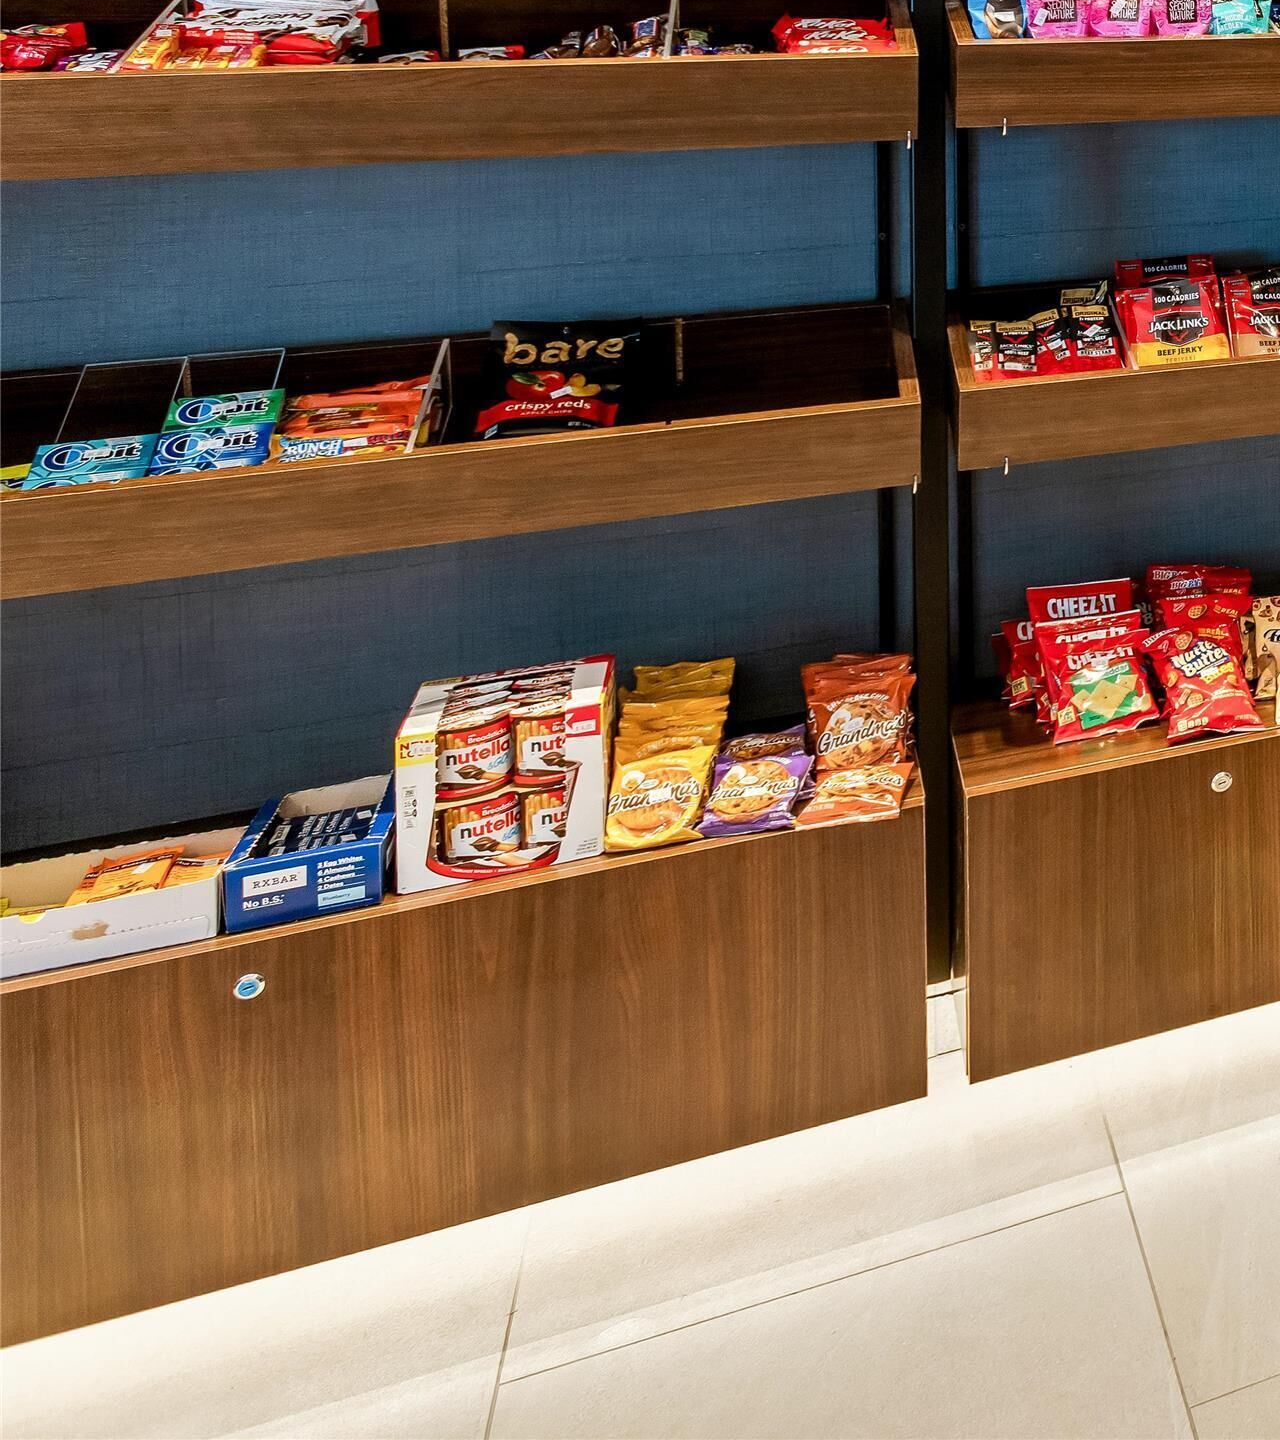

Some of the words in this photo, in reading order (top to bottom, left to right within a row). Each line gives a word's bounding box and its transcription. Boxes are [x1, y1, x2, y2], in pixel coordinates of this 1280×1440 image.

[1046, 0, 1076, 10] SECOND
[1046, 9, 1076, 21] NATURE
[1168, 9, 1196, 21] NATURE
[1155, 263, 1188, 273] CALORIES
[1153, 295, 1166, 304] 100
[1166, 291, 1200, 304] CALORIES
[1149, 321, 1177, 334] JACK
[504, 333, 624, 365] bare
[1157, 347, 1176, 357] BEEF
[1177, 345, 1204, 356] JERKY
[504, 399, 563, 413] crispy
[567, 397, 592, 412] reds
[816, 710, 907, 756] Grandma's
[445, 737, 511, 767] nutella
[459, 810, 521, 840] nutella
[251, 872, 299, 890] RXBAR
[242, 900, 259, 909] No
